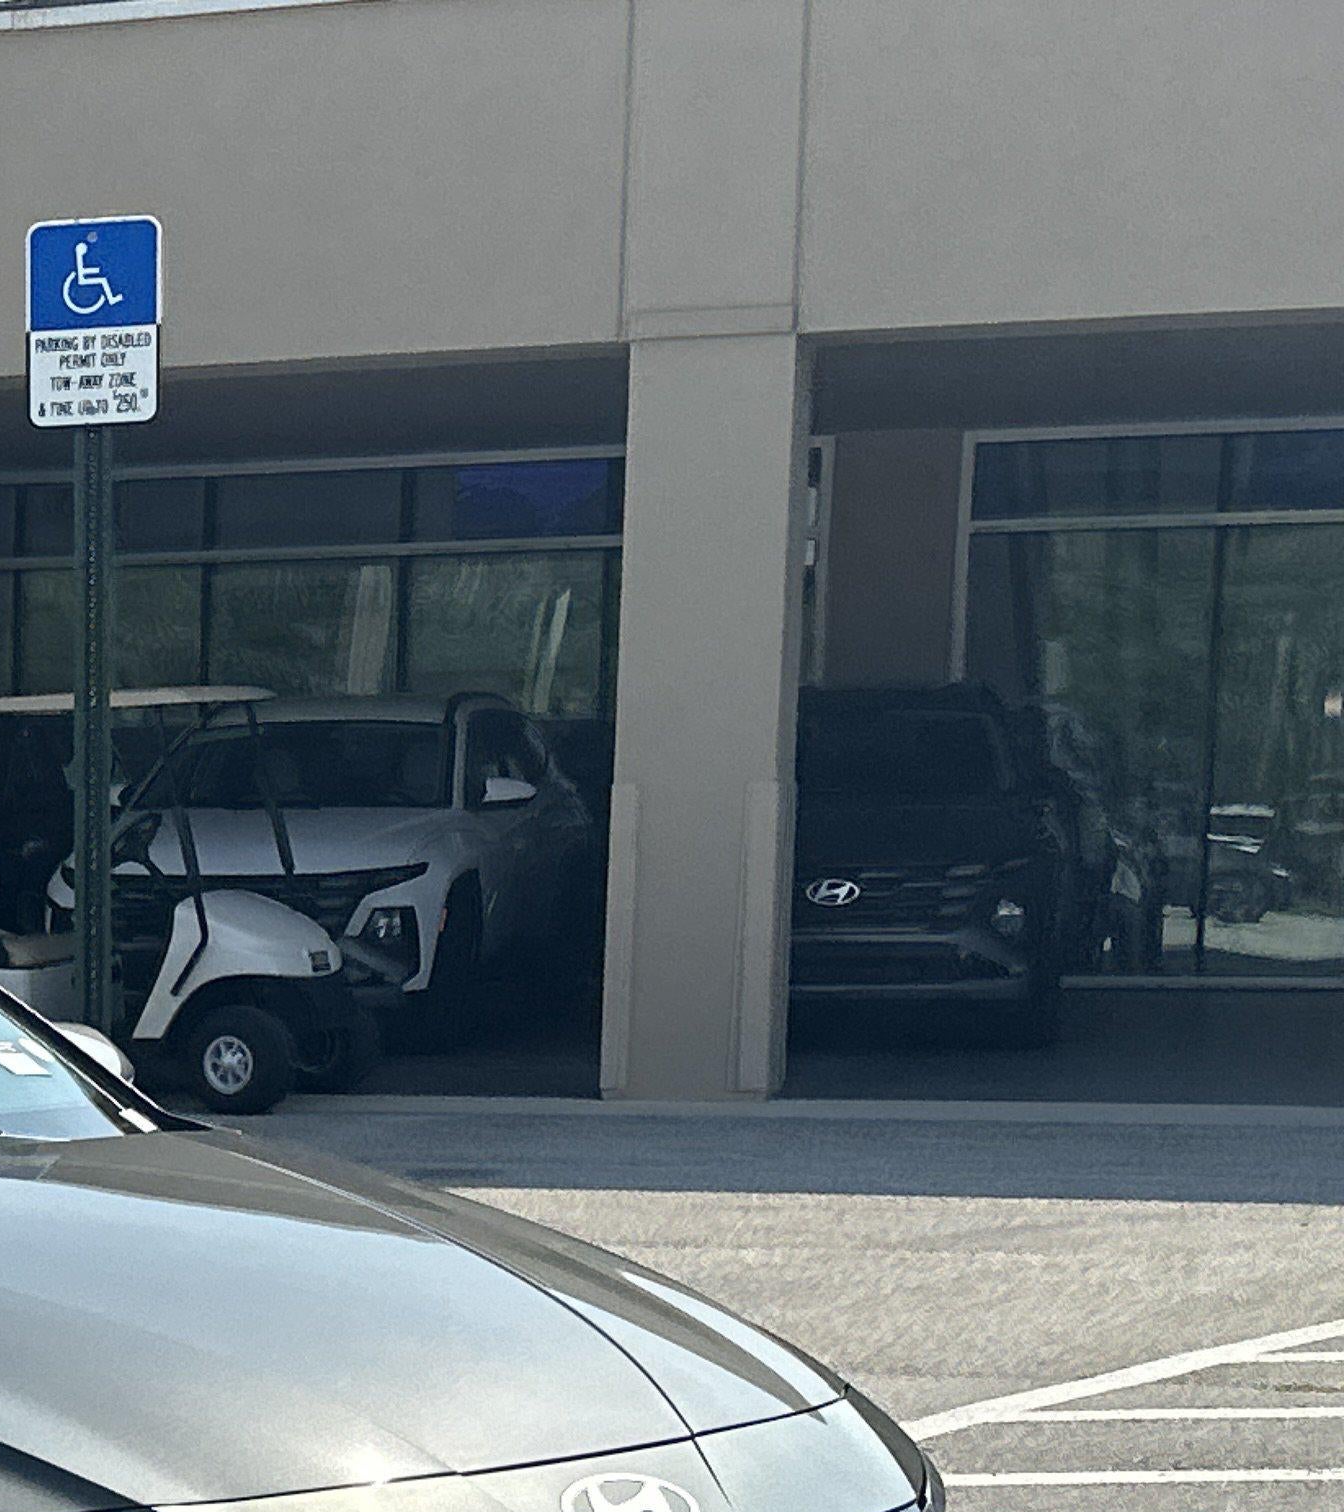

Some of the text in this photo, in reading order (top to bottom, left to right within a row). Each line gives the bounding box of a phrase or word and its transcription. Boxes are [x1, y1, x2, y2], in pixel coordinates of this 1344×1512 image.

[35, 331, 152, 353] PARKING BY DISABLED
[59, 351, 126, 370] PERMIT ONLY
[108, 371, 137, 389] ZONE
